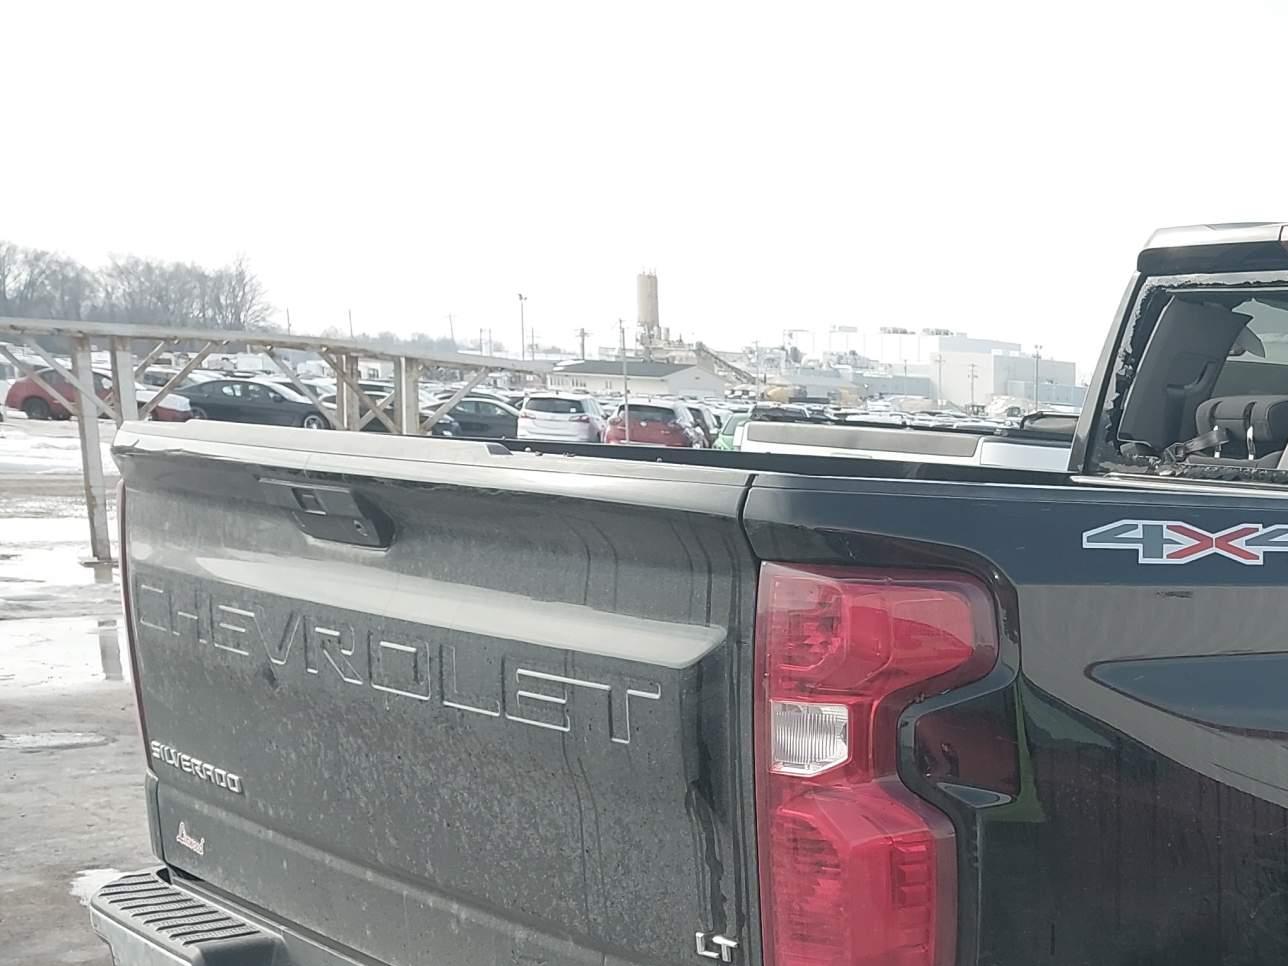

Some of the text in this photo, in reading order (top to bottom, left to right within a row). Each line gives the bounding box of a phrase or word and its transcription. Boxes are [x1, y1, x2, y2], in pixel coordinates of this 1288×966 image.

[139, 580, 663, 744] CHEVROLET
[151, 740, 240, 793] SILVERADO
[695, 932, 738, 962] LT
